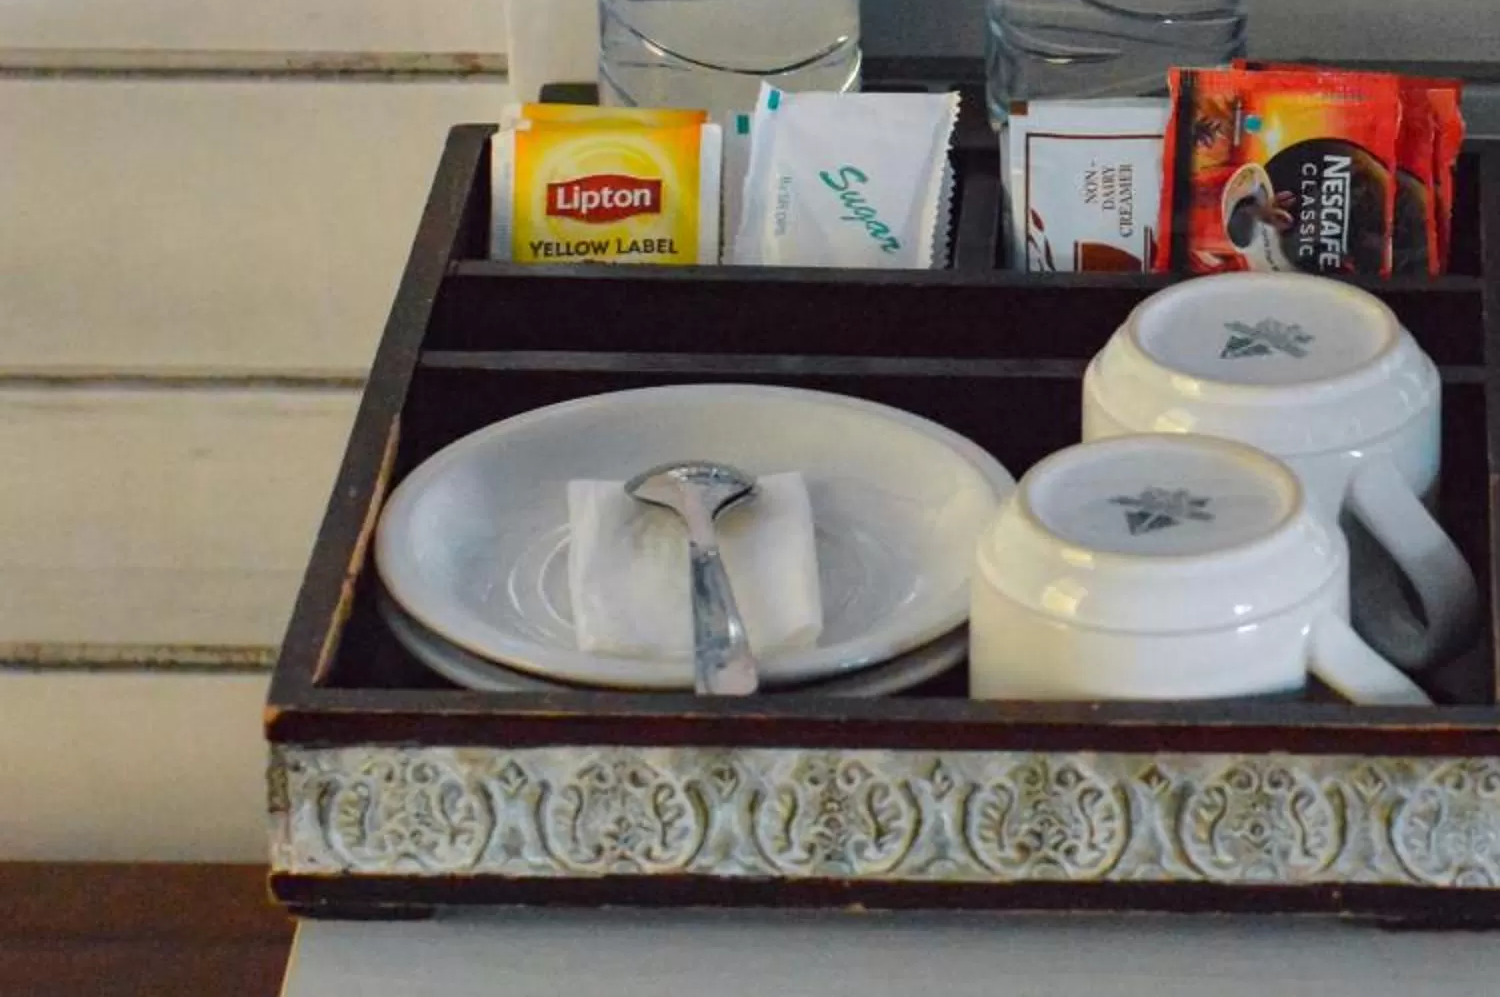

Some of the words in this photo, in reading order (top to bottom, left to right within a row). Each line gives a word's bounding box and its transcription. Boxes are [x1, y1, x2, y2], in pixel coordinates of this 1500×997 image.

[555, 185, 652, 214] Lipton
[818, 166, 902, 253] Sugar
[1101, 165, 1116, 212] DAIRY
[1119, 163, 1134, 238] CREAMER
[1299, 162, 1318, 257] CLASSIC
[529, 239, 611, 258] YELLOW
[616, 237, 680, 255] LABEL
